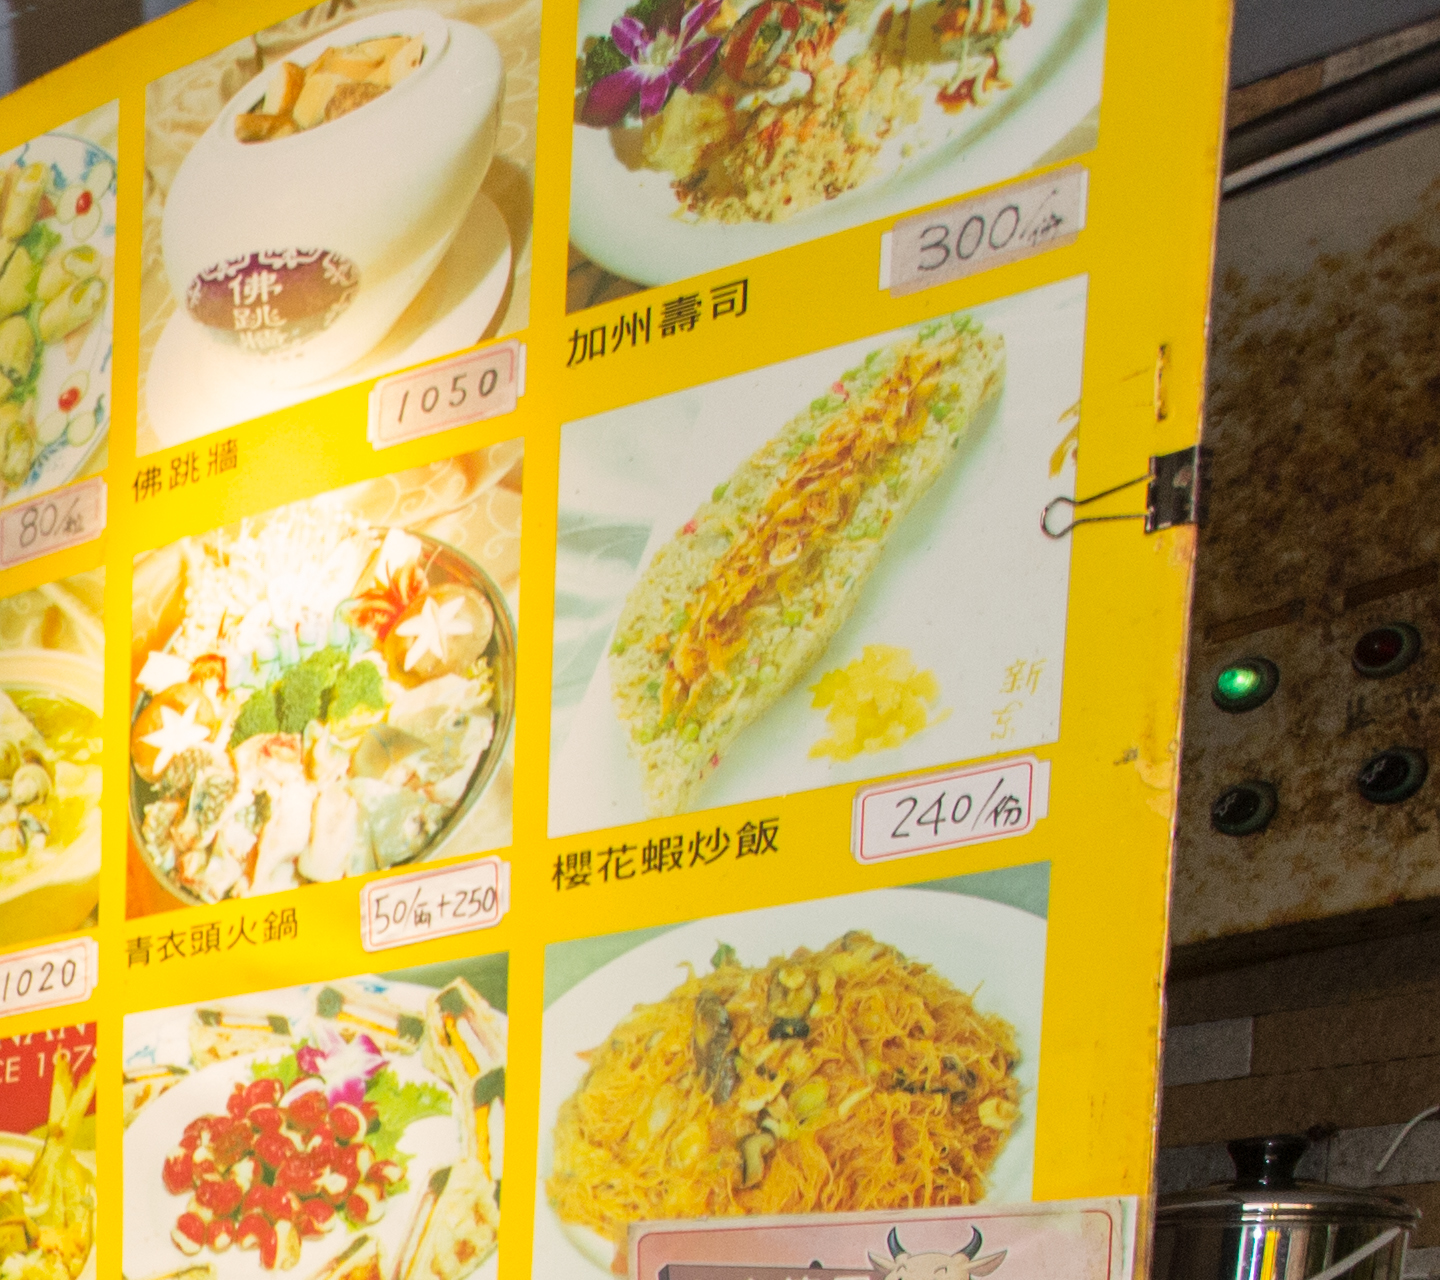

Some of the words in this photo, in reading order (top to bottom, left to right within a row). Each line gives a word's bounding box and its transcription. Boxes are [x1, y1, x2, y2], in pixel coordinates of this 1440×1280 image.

[566, 278, 749, 369] 加州壽司
[396, 368, 499, 425] 1050
[131, 439, 240, 505] 佛跳牆
[551, 817, 781, 894] 櫻花蝦炒飯
[124, 908, 300, 967] 青衣頭火鍋
[0, 960, 77, 1003] 1020
